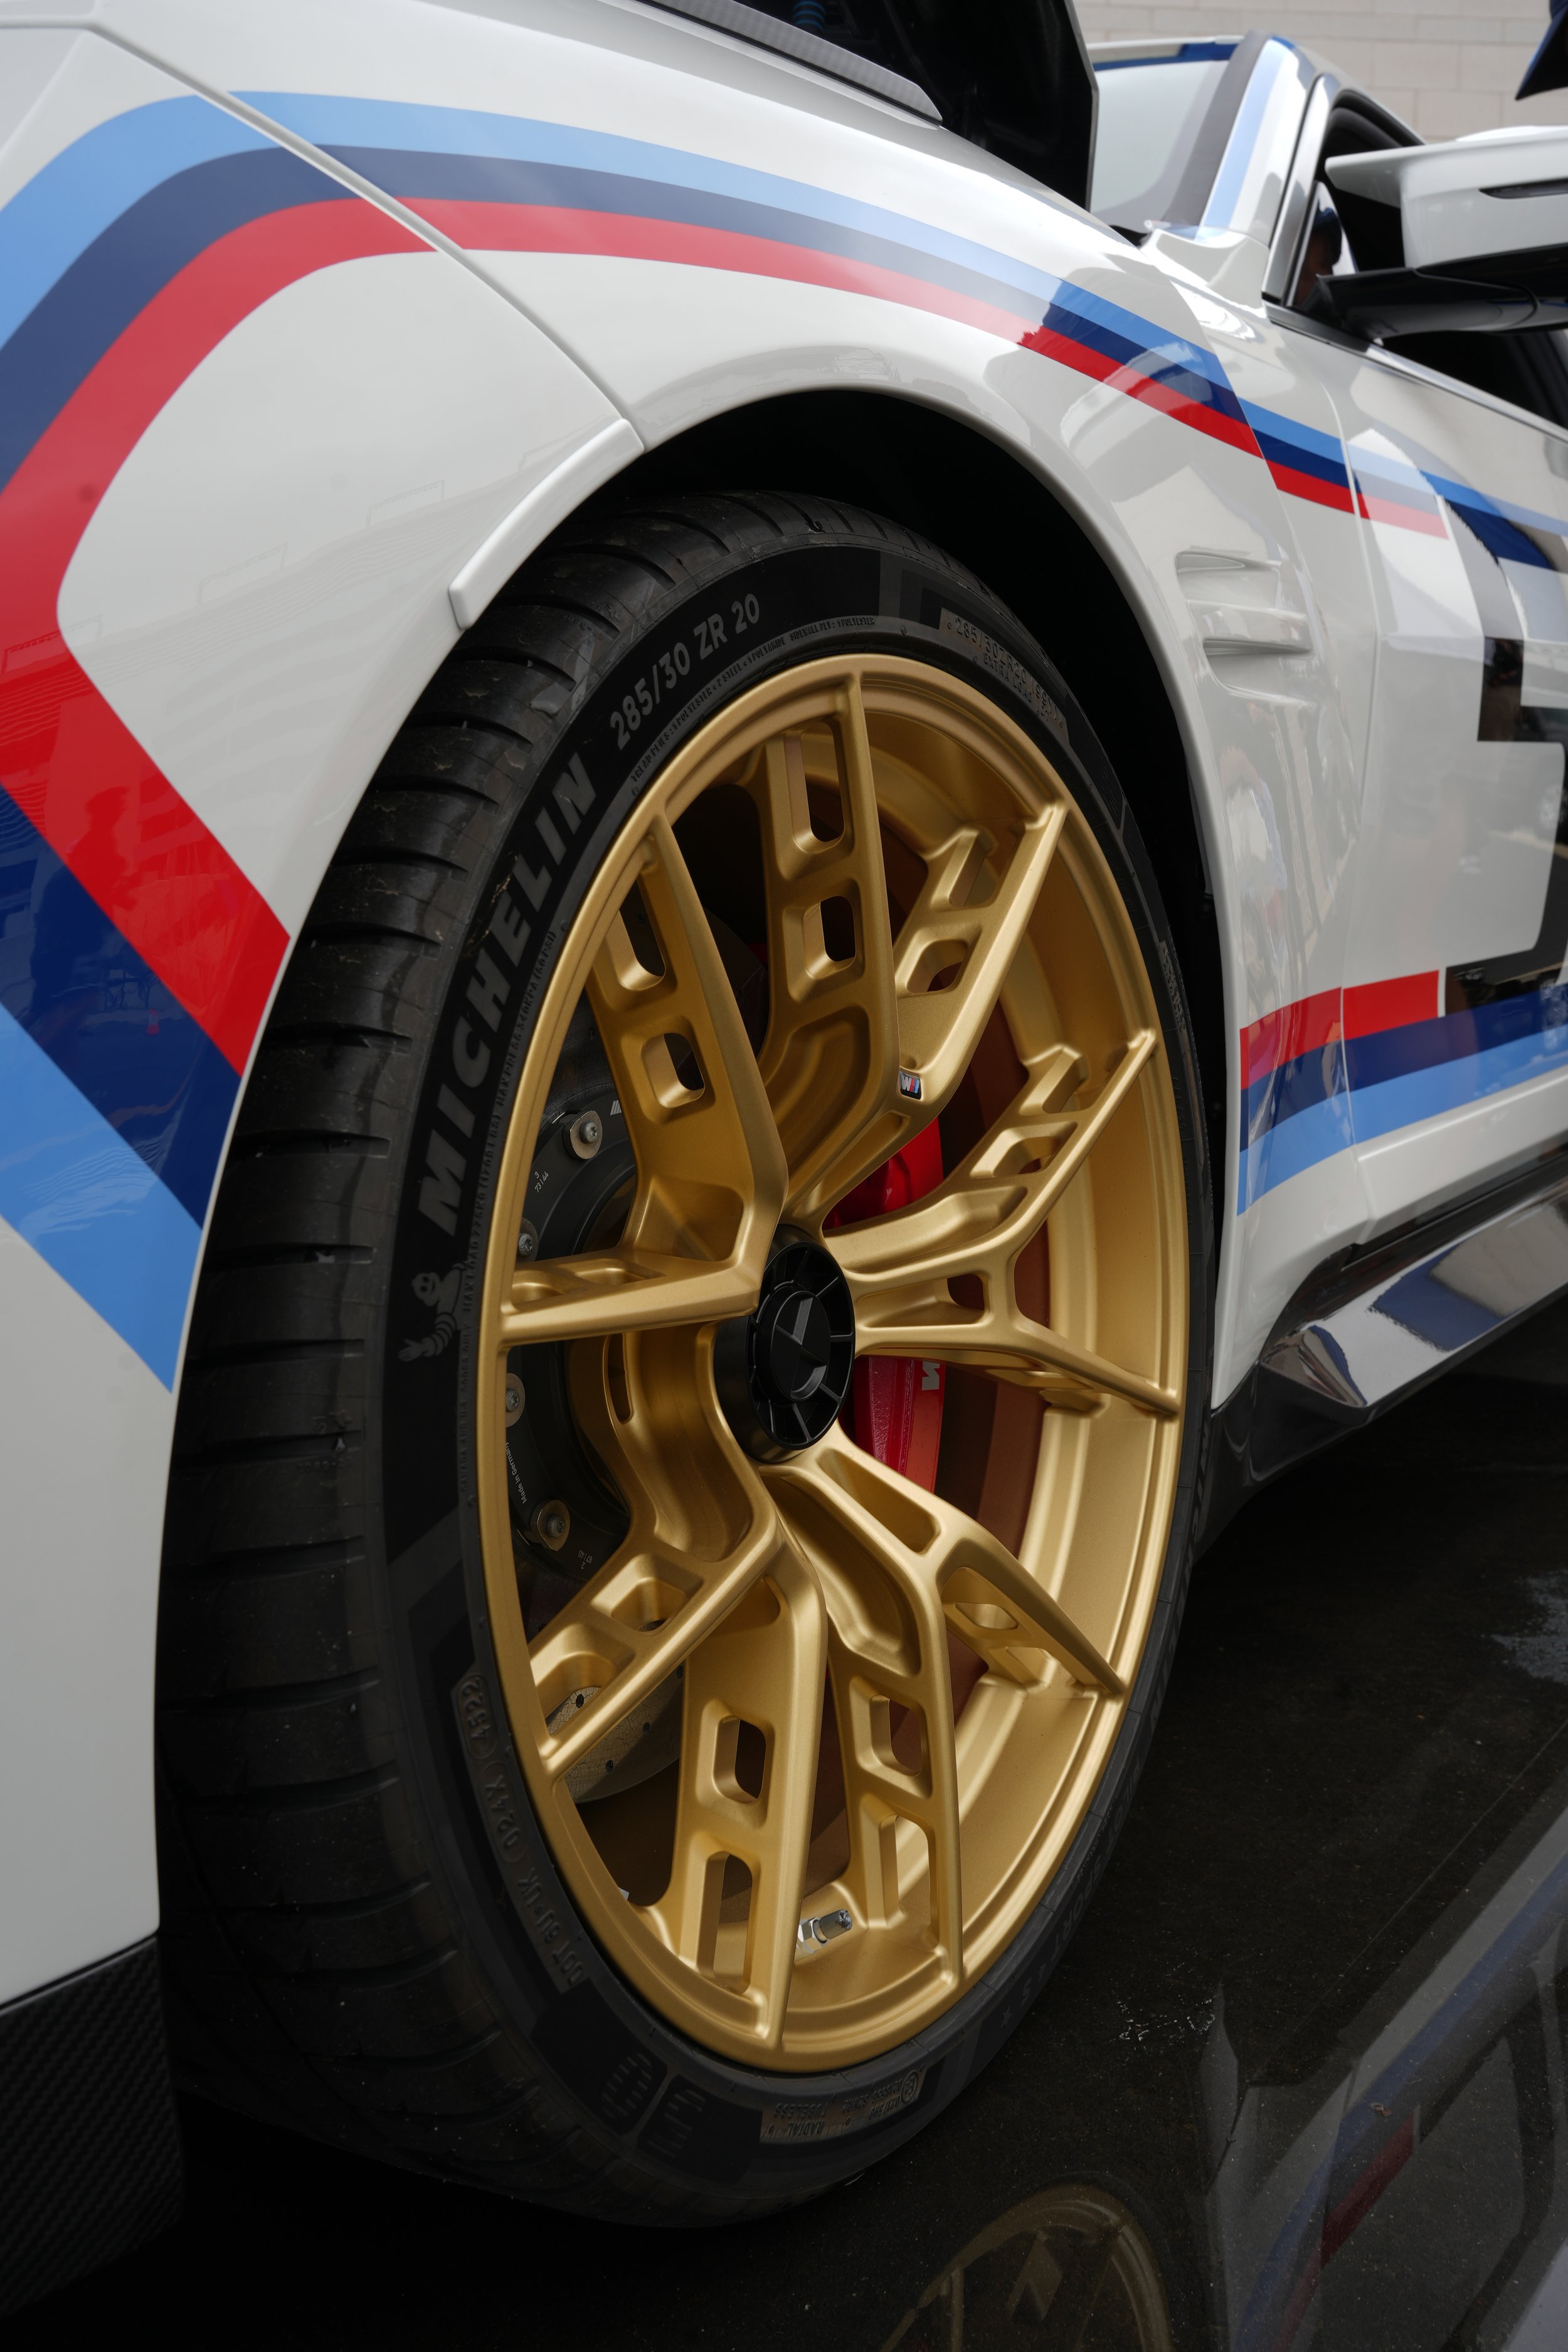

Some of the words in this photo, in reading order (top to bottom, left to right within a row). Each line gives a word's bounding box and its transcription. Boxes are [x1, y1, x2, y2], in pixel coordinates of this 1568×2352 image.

[787, 623, 820, 642] SIDEWALL
[840, 616, 876, 627] POLYESTER
[608, 642, 695, 750] 285/30
[693, 615, 731, 661] ZR
[729, 590, 762, 635] 20
[983, 651, 1012, 682] EXTRA
[416, 750, 597, 1237] MICHELIN
[461, 1281, 475, 1313] MAX
[494, 1076, 511, 1108] MAX
[515, 1475, 521, 1485] in
[517, 1483, 528, 1505] Made
[1148, 1419, 1210, 1737] MICHELIN
[458, 1676, 492, 1744] 4522
[481, 1772, 524, 1850] 024X
[1106, 1755, 1142, 1856] PILOT
[1051, 1852, 1101, 1963] SPORT
[551, 1938, 585, 1986] DOT
[771, 2103, 829, 2119] TUBELESS
[787, 2119, 825, 2136] RADIAL
